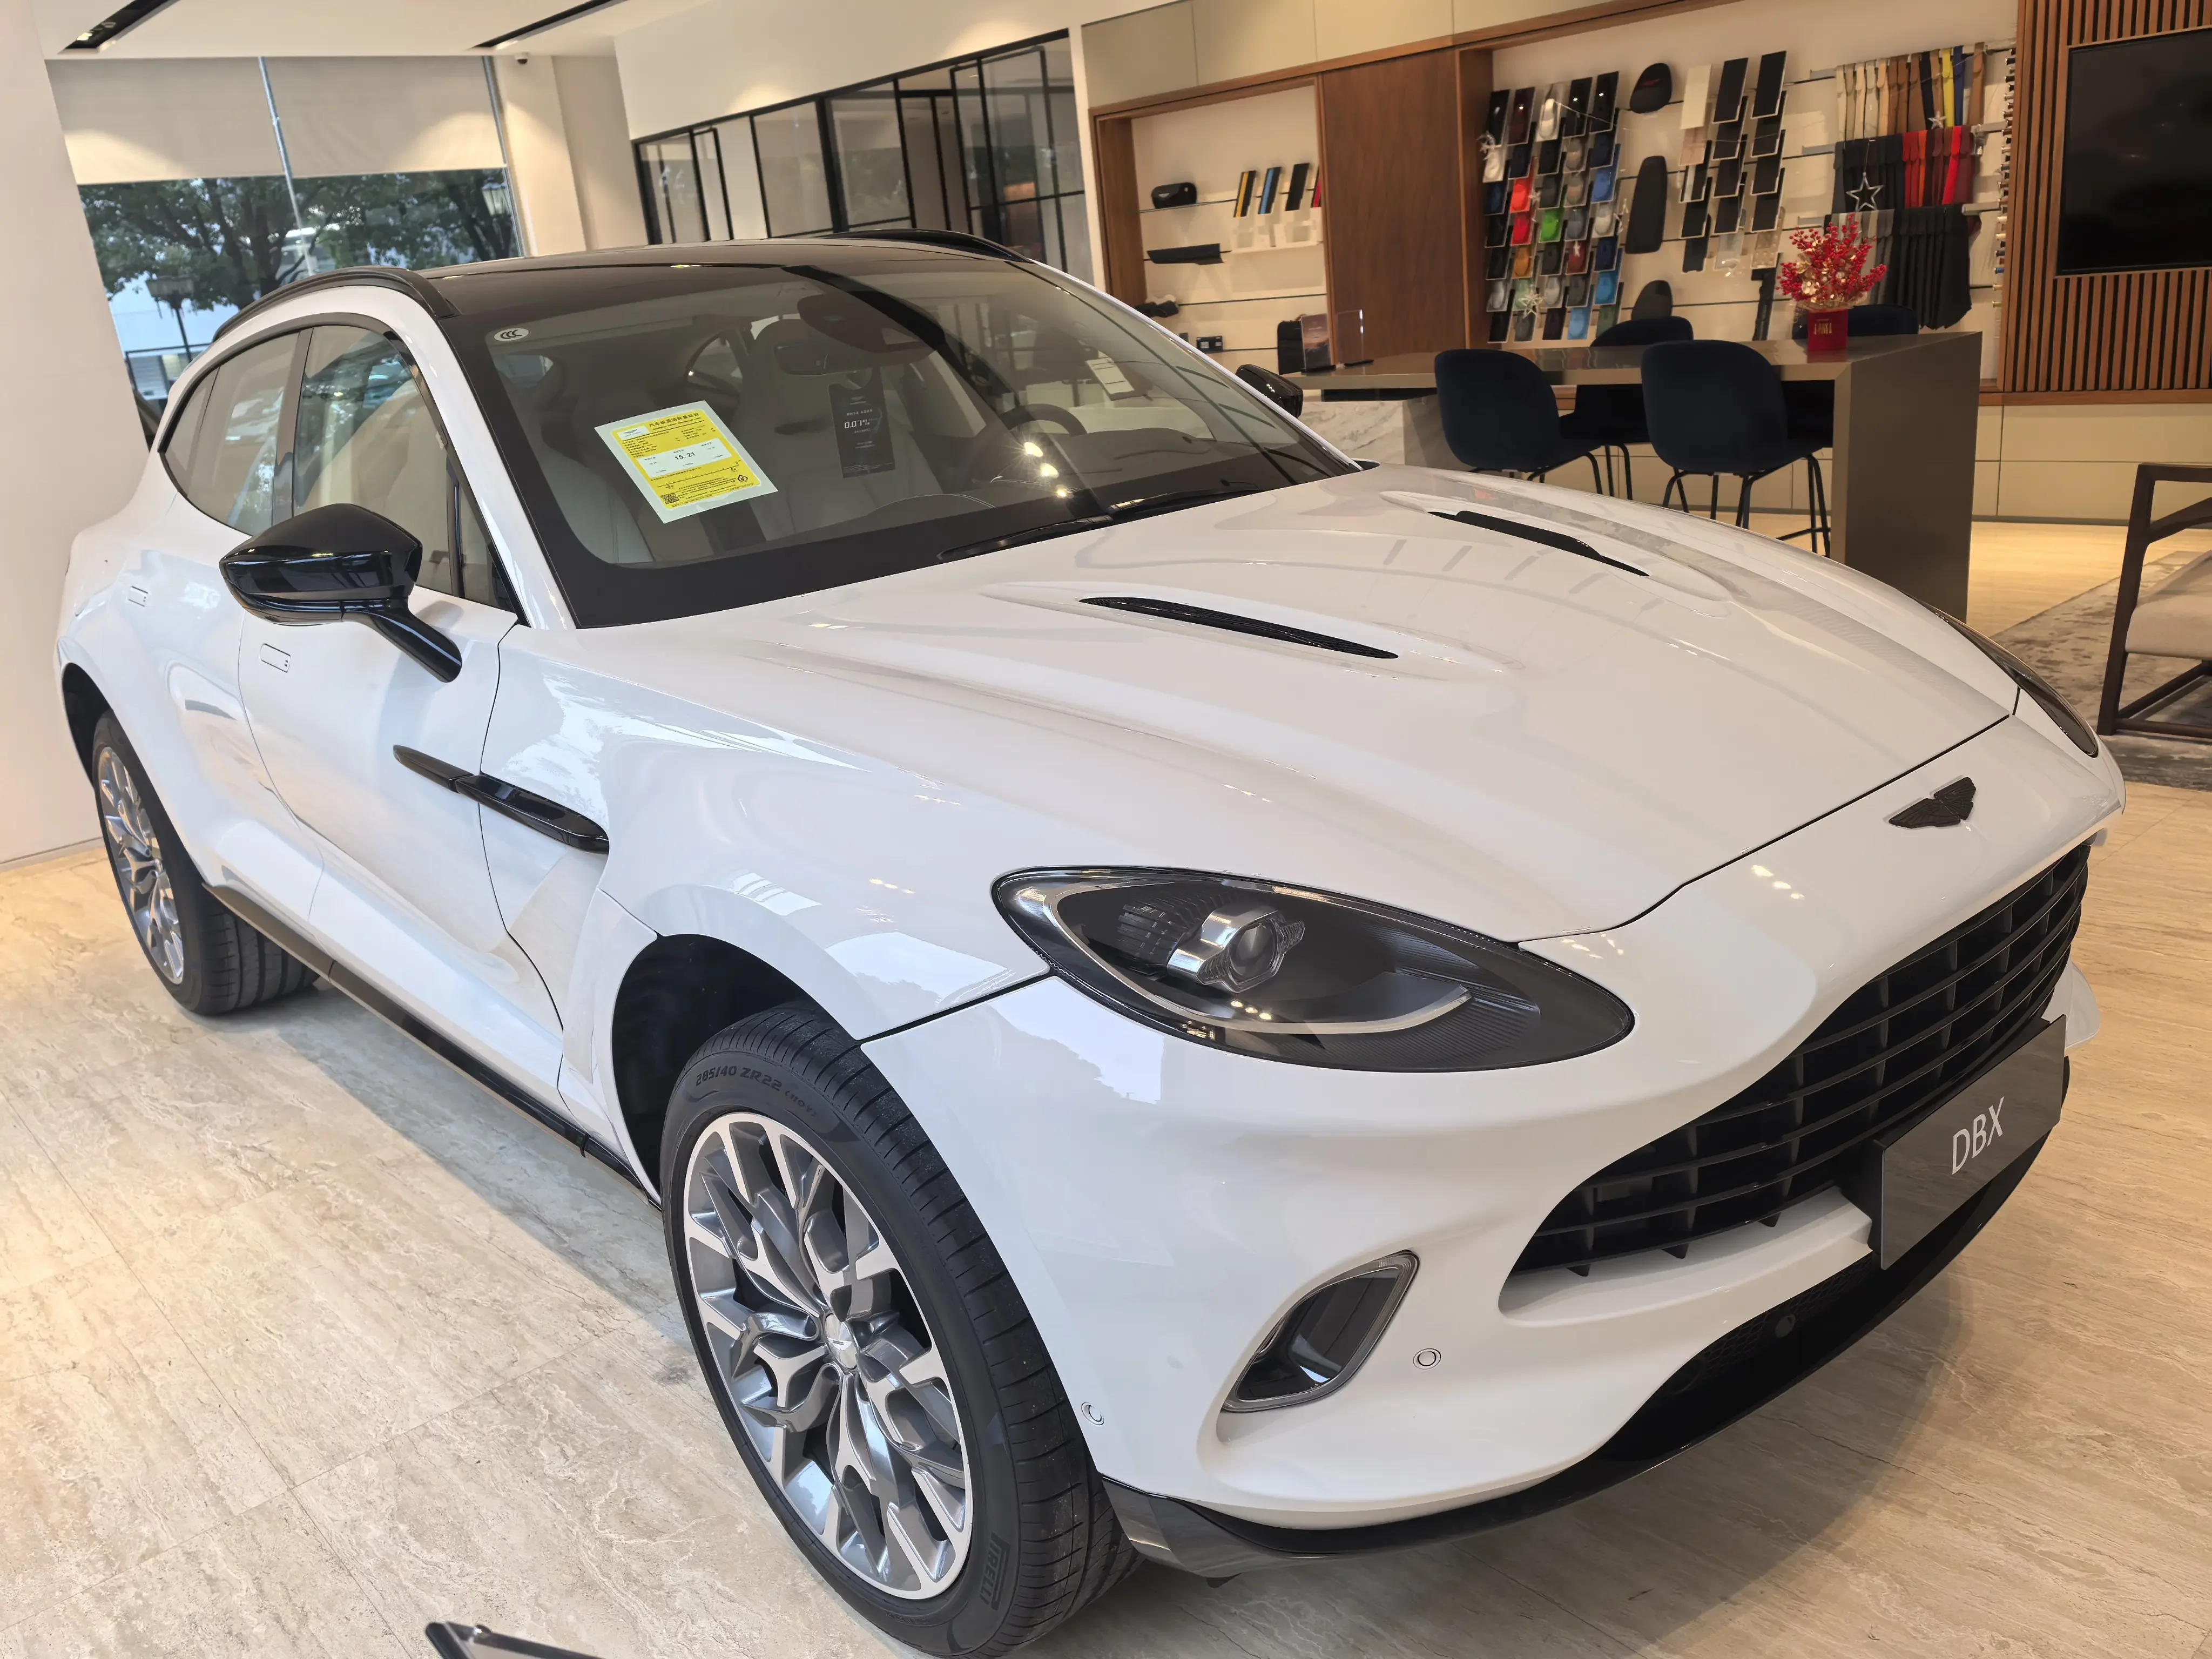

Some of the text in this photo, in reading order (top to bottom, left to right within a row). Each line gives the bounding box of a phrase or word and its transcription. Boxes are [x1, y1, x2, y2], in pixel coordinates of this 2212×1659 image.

[675, 452, 696, 460] 15.21
[696, 1065, 737, 1086] 285/40
[740, 1067, 783, 1091] ZR22
[1952, 1096, 2005, 1175] DBX
[979, 1531, 1011, 1611] PIRELLI
